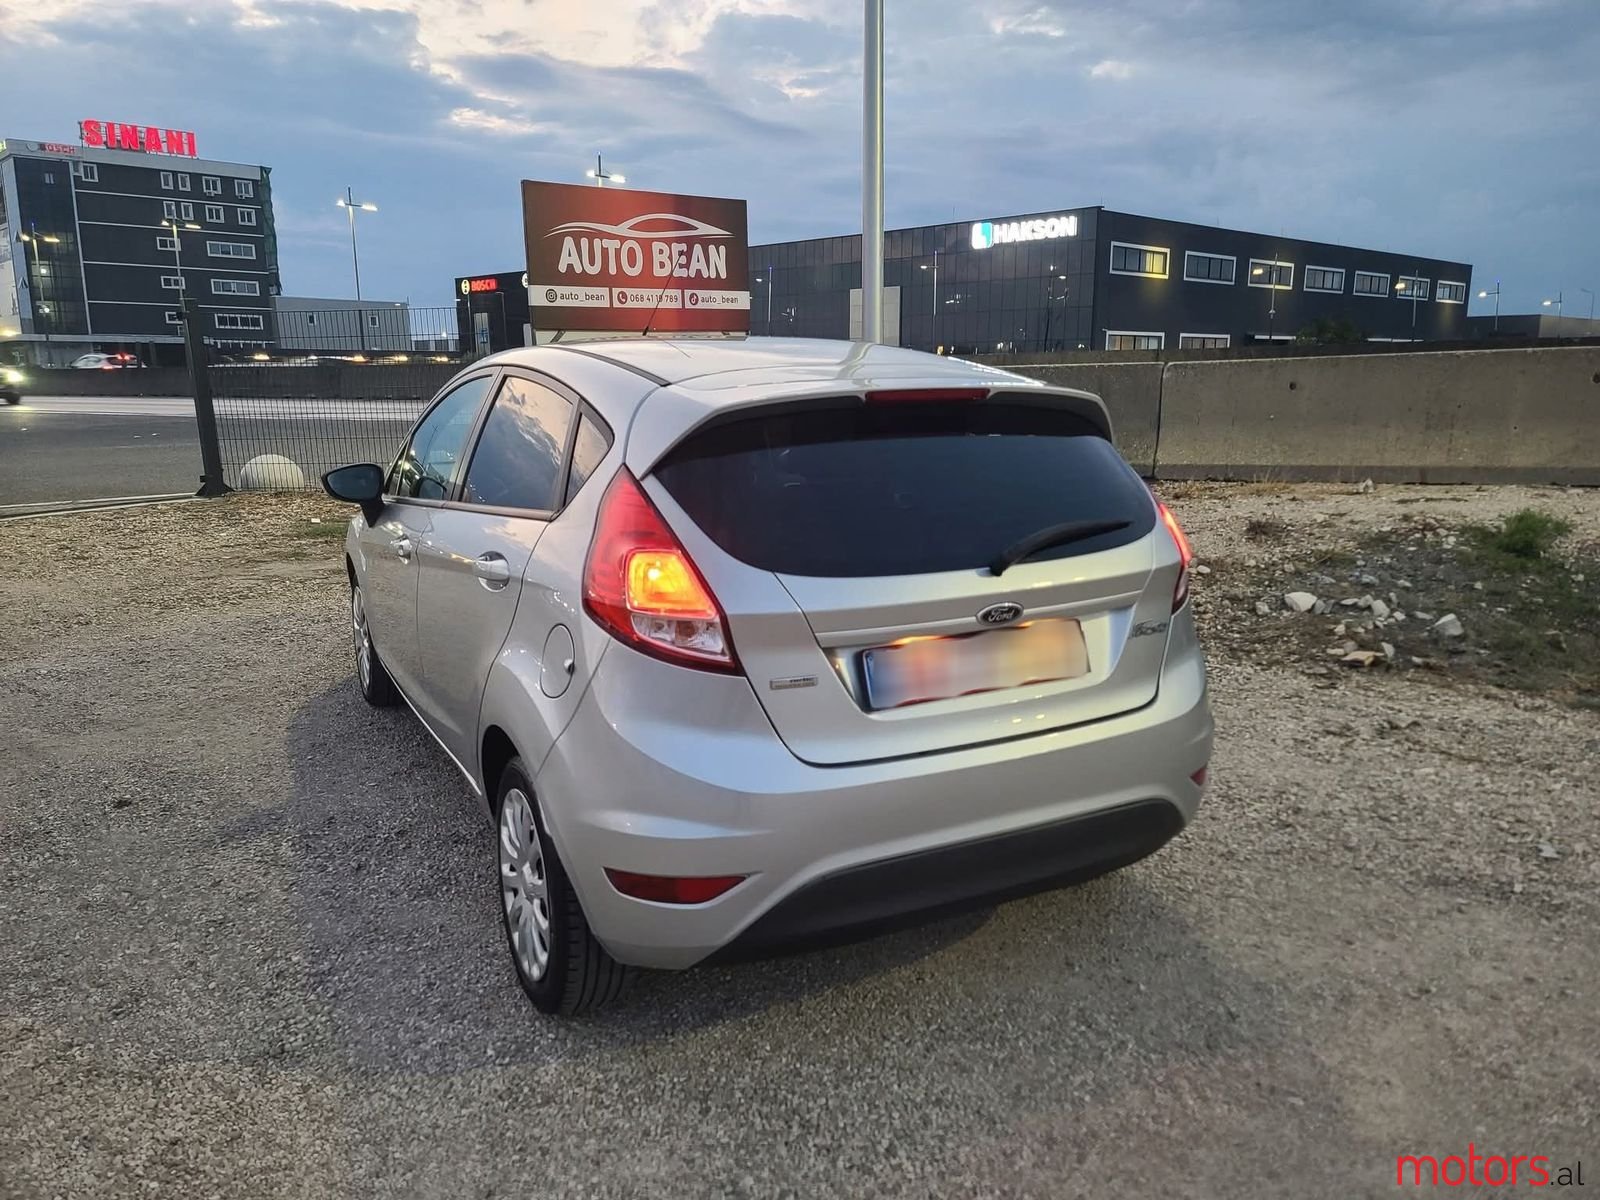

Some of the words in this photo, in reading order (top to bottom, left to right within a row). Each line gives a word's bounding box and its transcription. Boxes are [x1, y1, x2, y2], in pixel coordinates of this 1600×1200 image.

[82, 119, 197, 157] SINANI
[993, 215, 1078, 244] HAKSON
[557, 236, 644, 277] AUTO
[651, 241, 727, 279] BEAN
[559, 292, 605, 302] auto_bean
[630, 294, 645, 302] 068
[646, 294, 654, 303] 41
[664, 294, 679, 303] 789
[700, 296, 739, 304] auto_bean
[988, 608, 1015, 622] Ford
